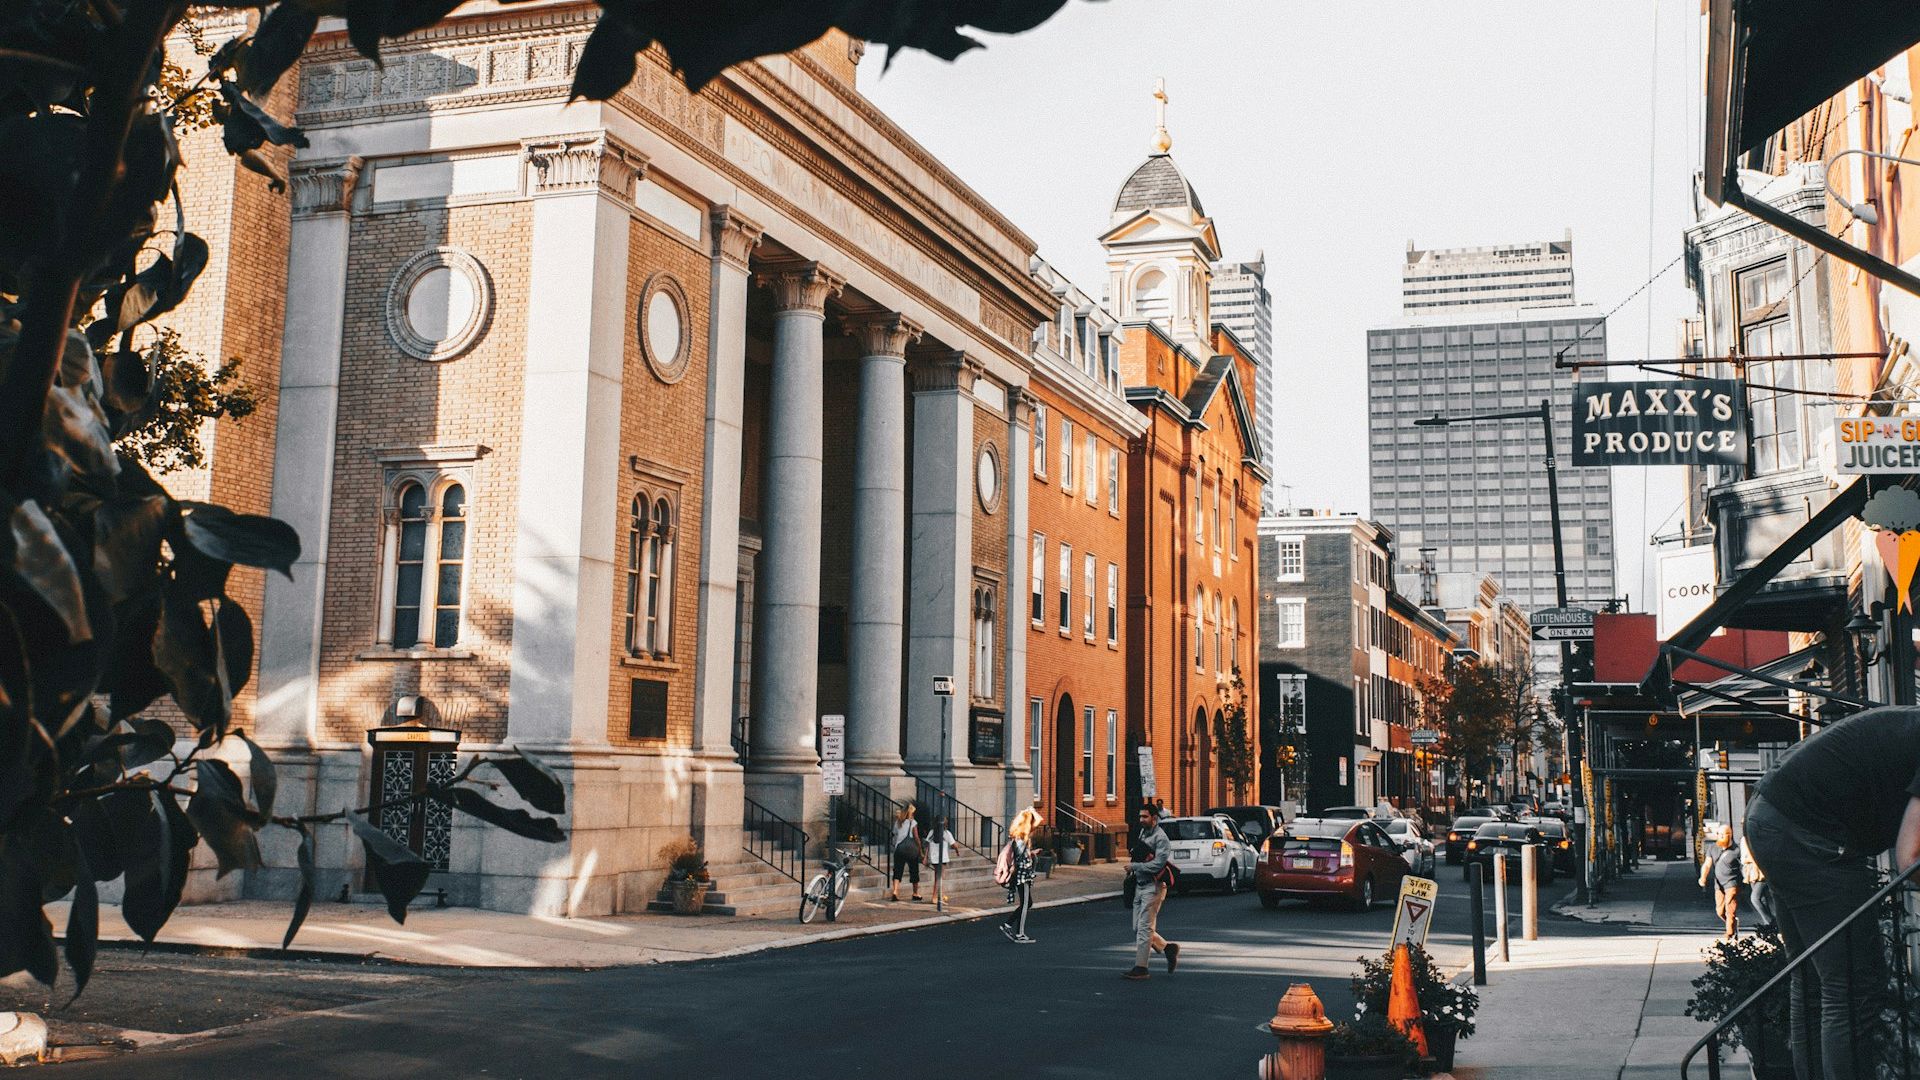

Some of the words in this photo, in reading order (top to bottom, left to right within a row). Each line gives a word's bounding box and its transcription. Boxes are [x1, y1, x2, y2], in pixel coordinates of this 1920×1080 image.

[1585, 388, 1733, 424] MAXX'S
[1583, 430, 1737, 454] PRODUCE
[1844, 445, 1920, 468] JUICER
[1668, 583, 1710, 599] COOK
[1532, 613, 1587, 624] RITTENHOUSE
[1550, 629, 1568, 637] ONE
[1571, 629, 1590, 637] WAY
[1410, 880, 1433, 891] STATE
[1412, 889, 1427, 898] LAW
